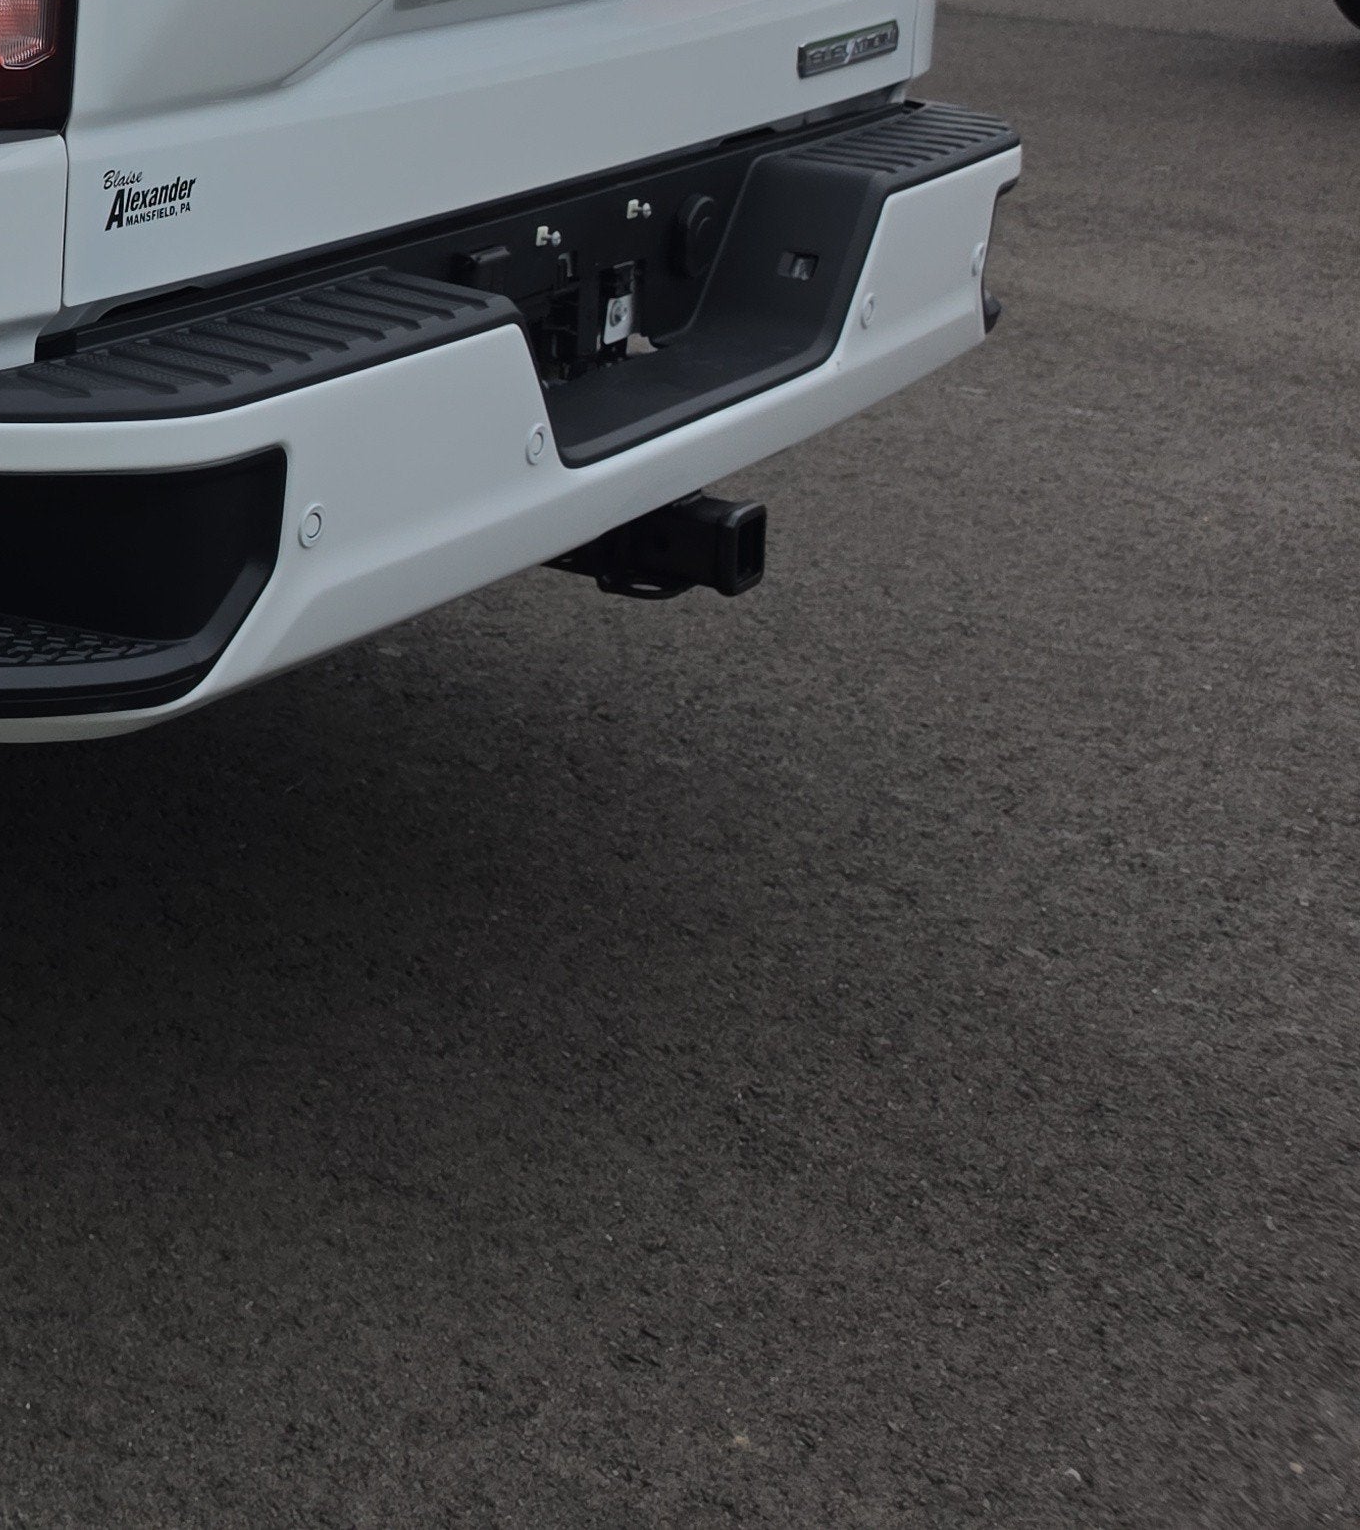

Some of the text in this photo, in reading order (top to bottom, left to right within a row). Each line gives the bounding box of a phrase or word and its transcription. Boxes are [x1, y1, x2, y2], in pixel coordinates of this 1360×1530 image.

[102, 169, 143, 190] Blaise
[105, 176, 197, 231] Alexander
[125, 201, 191, 227] MANSFIELD, PA
